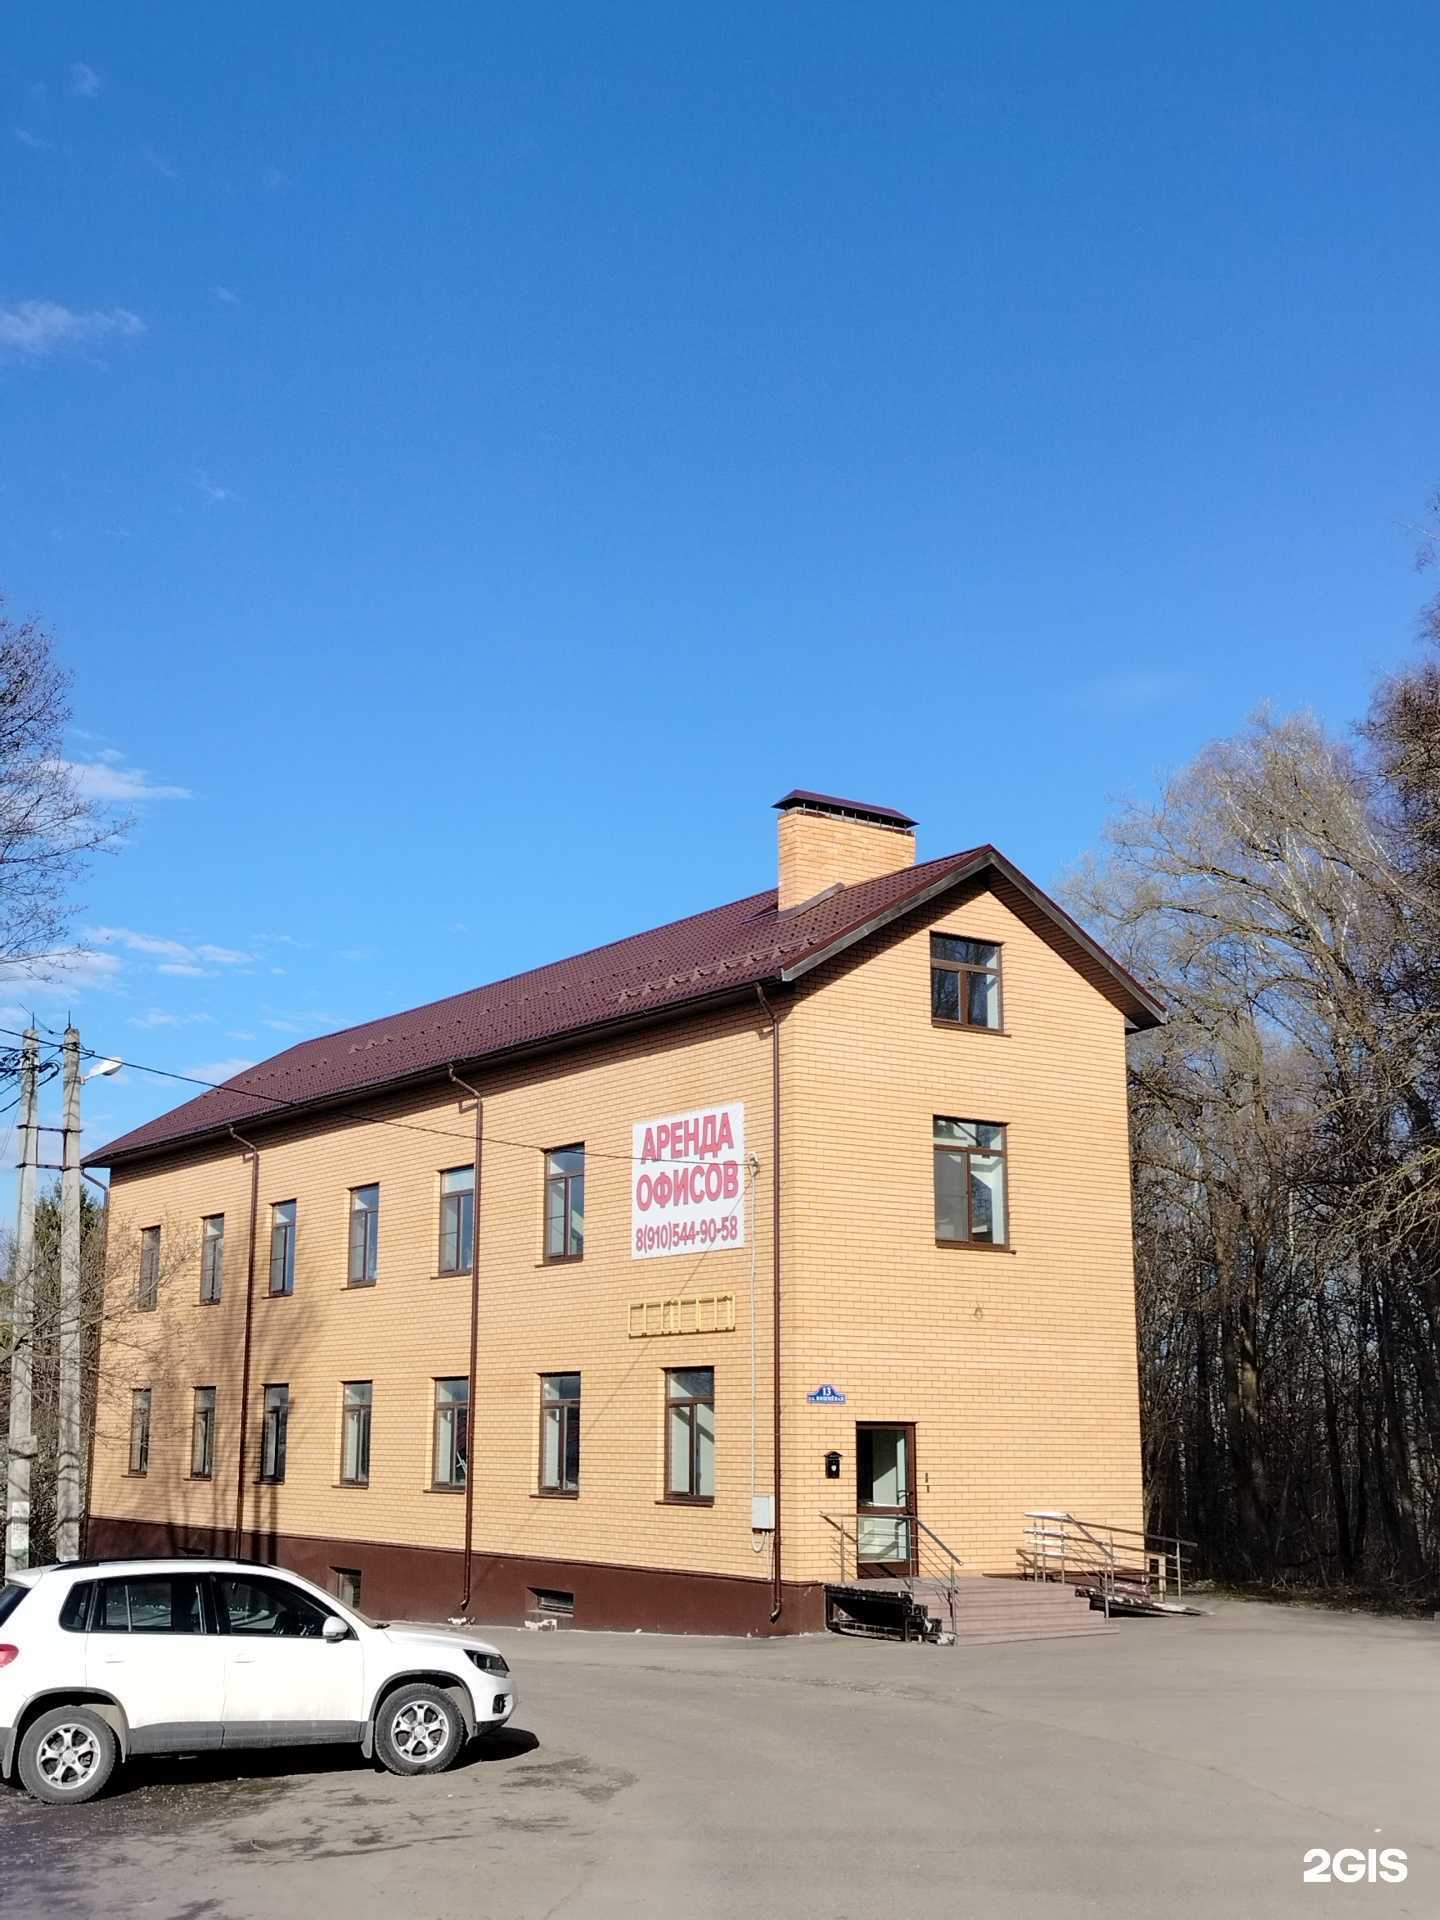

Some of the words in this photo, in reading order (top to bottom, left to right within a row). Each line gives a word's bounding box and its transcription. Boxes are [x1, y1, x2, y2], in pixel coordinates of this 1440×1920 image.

[641, 1112, 734, 1164] АРЕНДА
[636, 1160, 739, 1211] ОФИСОВ
[635, 1216, 738, 1253] 8(910)544-90-58
[822, 1387, 832, 1396] 13
